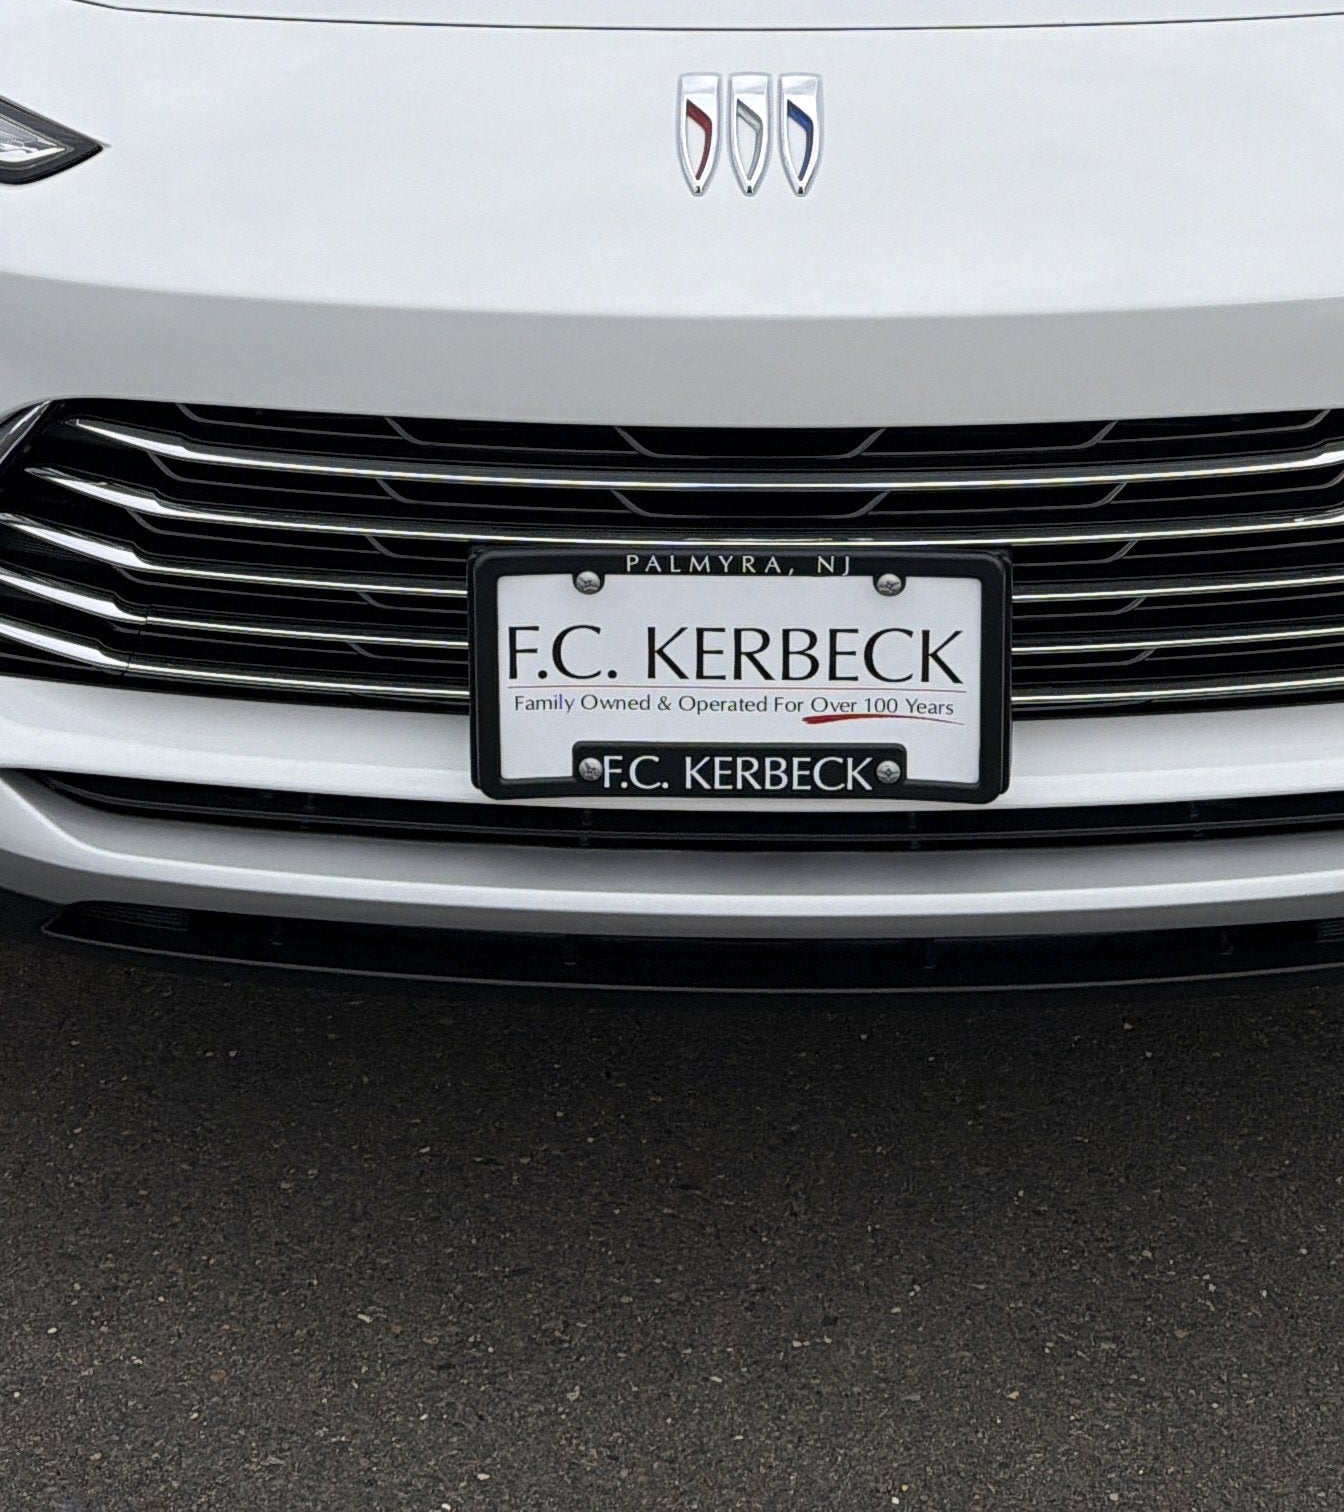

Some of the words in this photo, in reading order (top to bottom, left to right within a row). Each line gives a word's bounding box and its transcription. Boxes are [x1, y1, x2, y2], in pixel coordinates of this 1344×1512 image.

[626, 554, 794, 576] PALMYRA,
[817, 555, 851, 576] NJ
[508, 624, 618, 680] F.C.
[647, 626, 963, 684] KERBECK
[514, 694, 576, 714] Family
[580, 694, 651, 711] Owned
[657, 695, 672, 711] &
[678, 695, 768, 716] Operated
[774, 696, 805, 713] For
[810, 696, 858, 713] Over
[864, 697, 898, 714] 100
[905, 698, 955, 716] Years
[603, 755, 669, 790] F.C.
[685, 756, 874, 791] KERBECK
